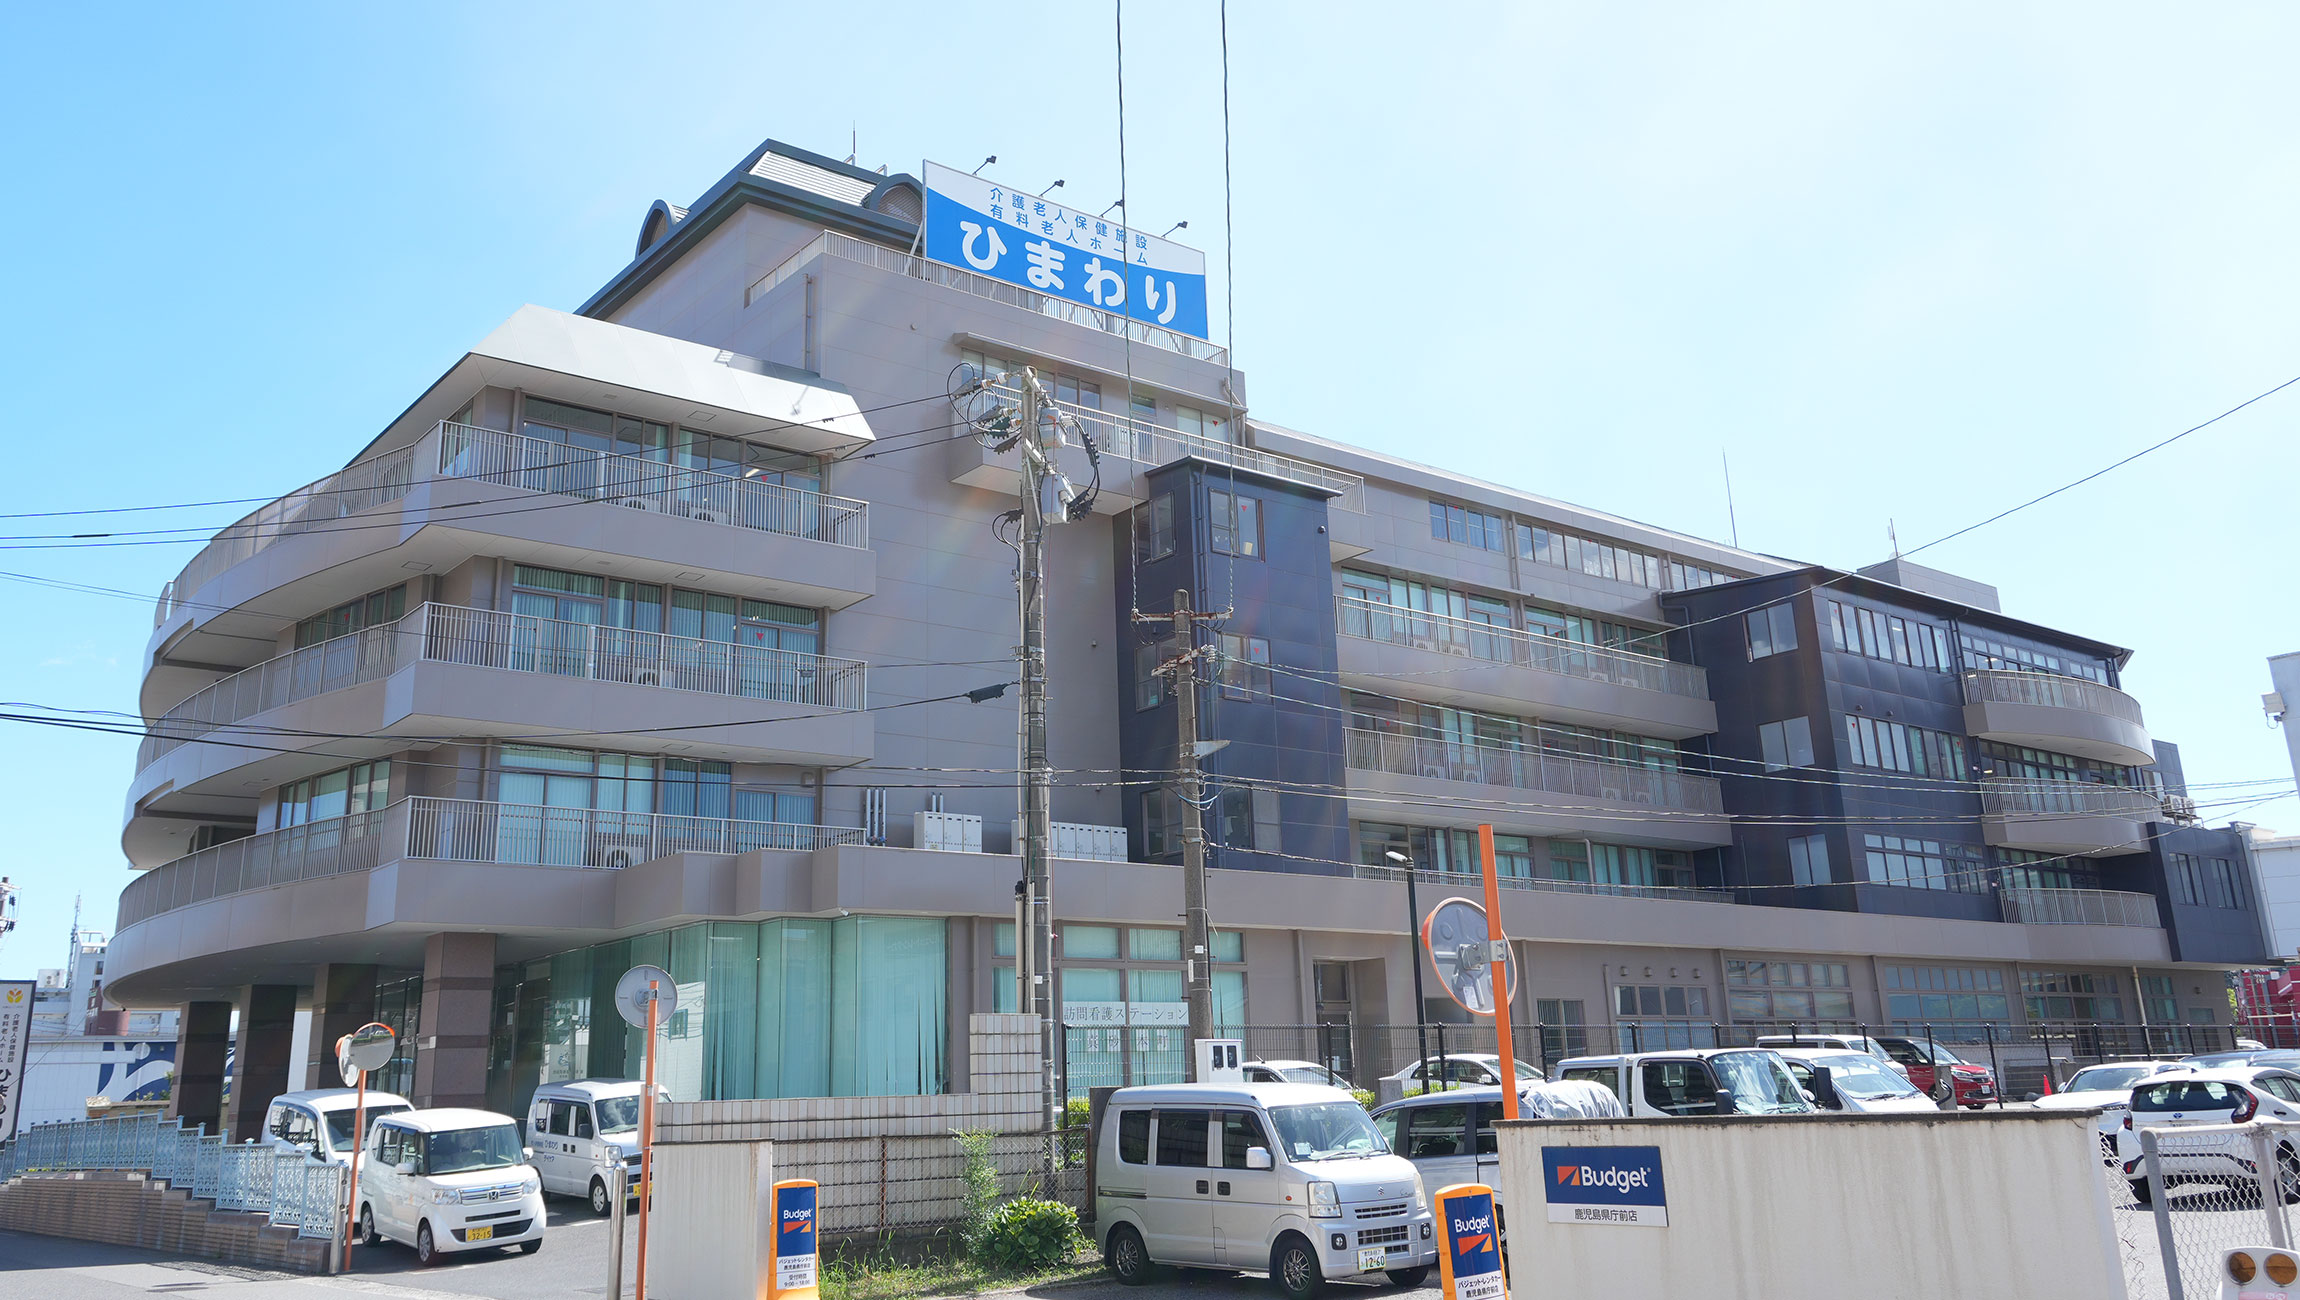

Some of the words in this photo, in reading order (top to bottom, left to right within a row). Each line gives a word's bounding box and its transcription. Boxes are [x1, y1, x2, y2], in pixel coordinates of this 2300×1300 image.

[990, 187, 1148, 250] 介護老人保健施設
[990, 204, 1148, 266] 有料老人ホーム
[960, 220, 1177, 324] ひまわり
[1063, 1006, 1188, 1022] 訪問看護ステーション
[1581, 1166, 1648, 1194] Budget
[783, 1209, 812, 1221] Budget
[1574, 1208, 1638, 1222] 鹿児島県庁前店
[1454, 1216, 1490, 1234] Budget
[1465, 1285, 1499, 1298] 鹿児島県庁前店
